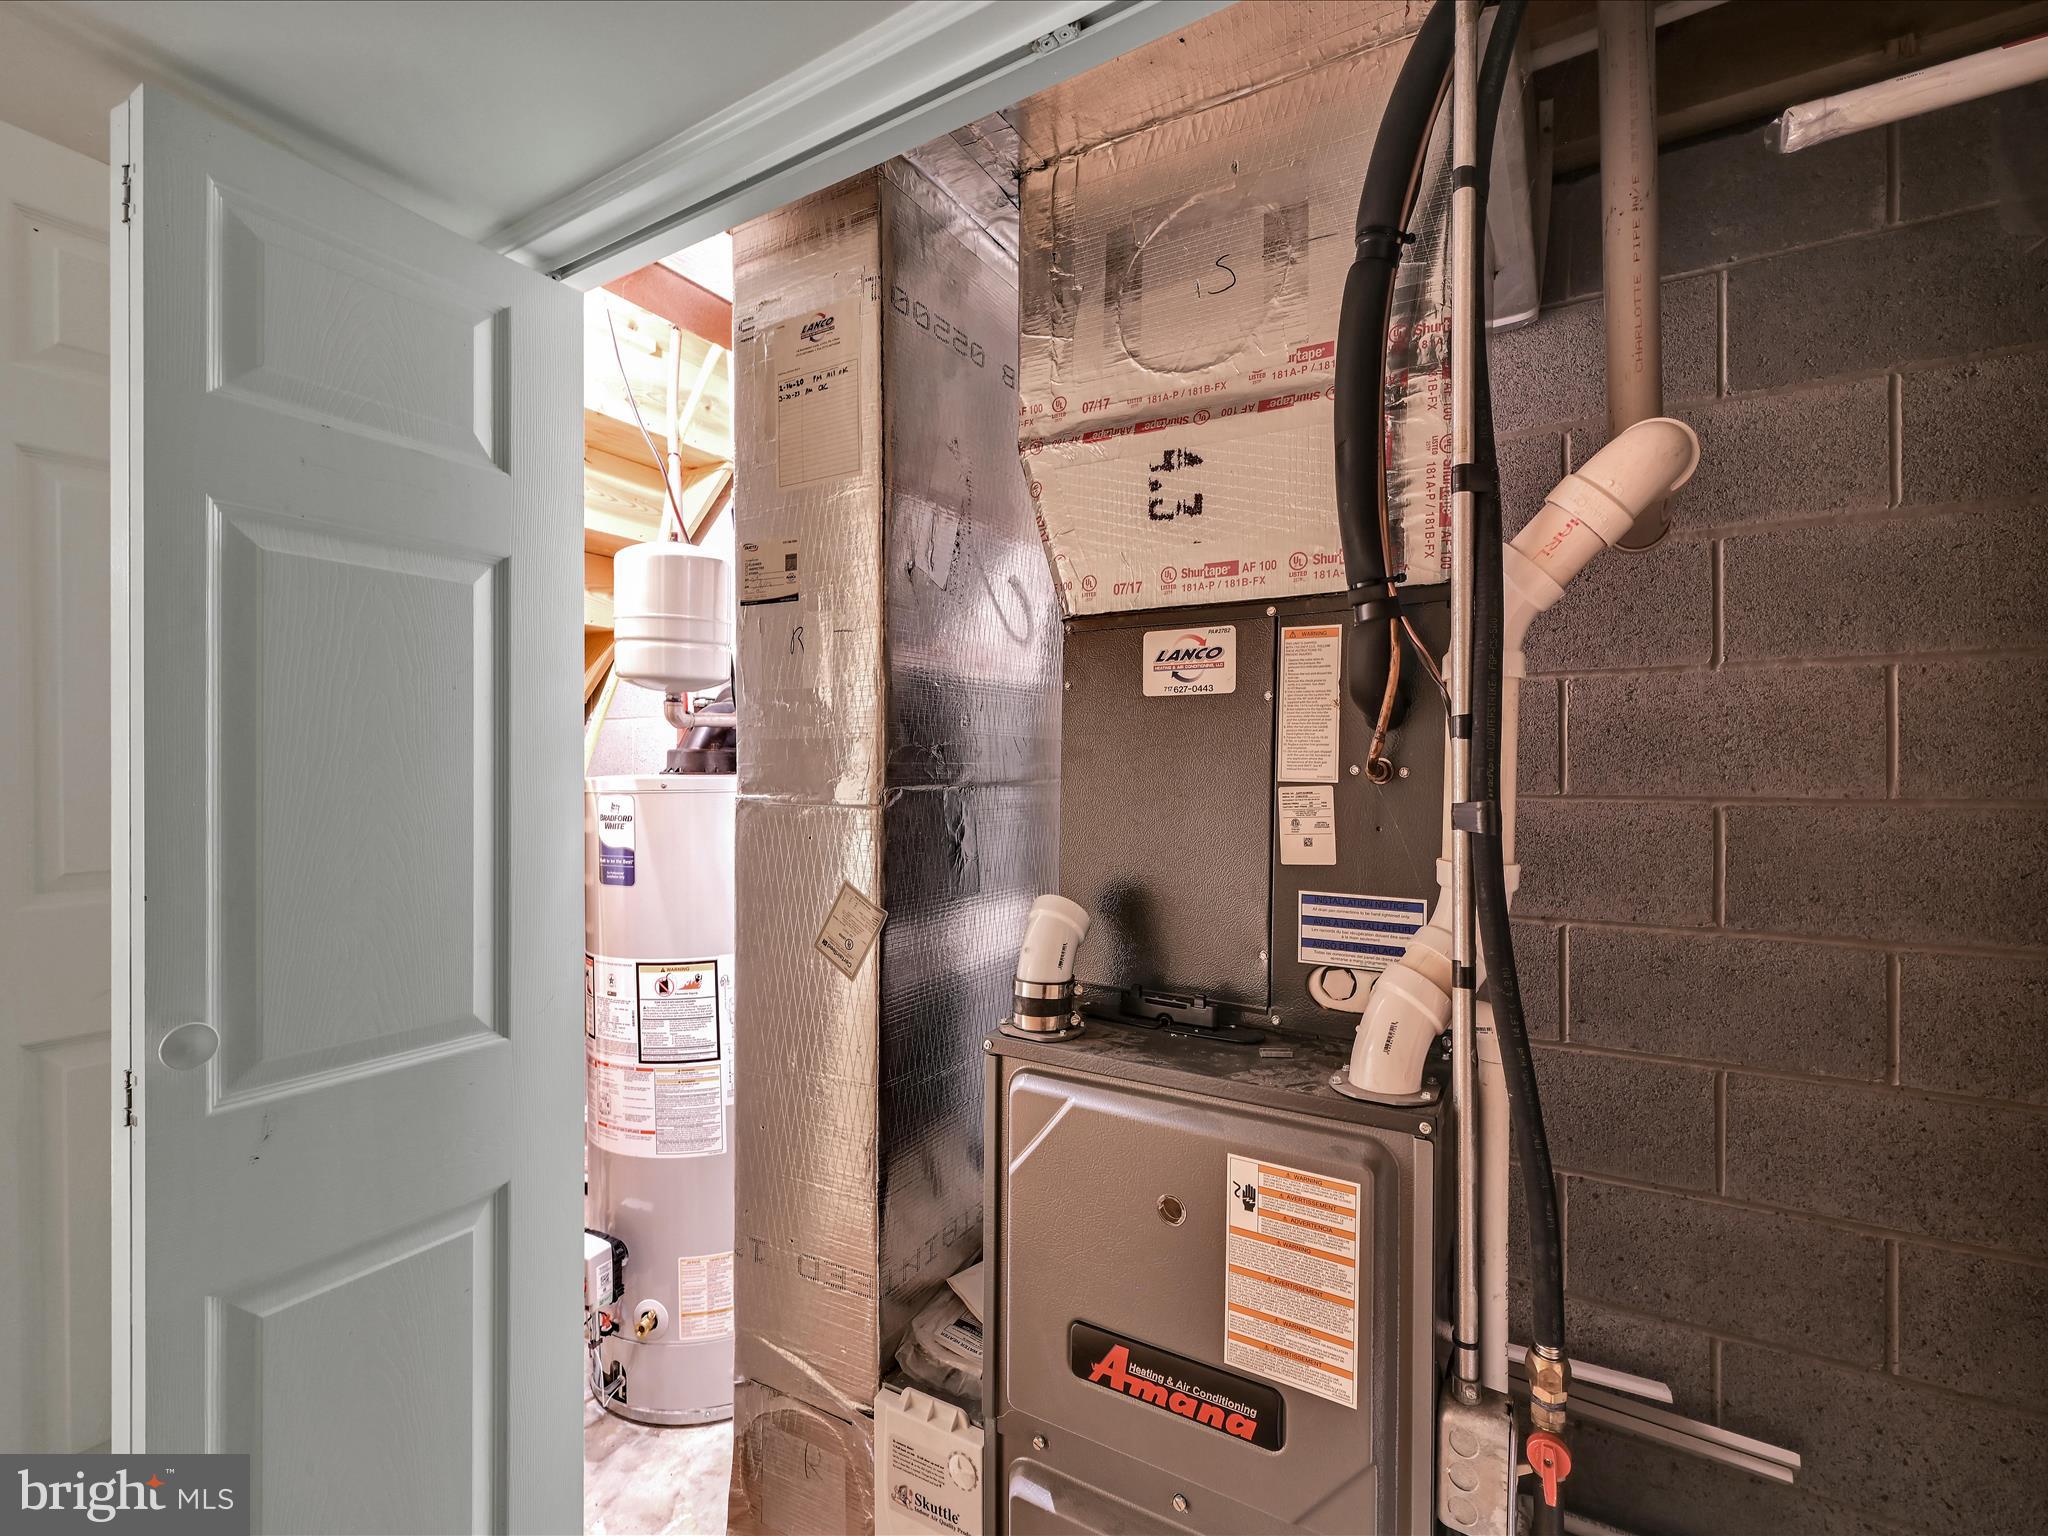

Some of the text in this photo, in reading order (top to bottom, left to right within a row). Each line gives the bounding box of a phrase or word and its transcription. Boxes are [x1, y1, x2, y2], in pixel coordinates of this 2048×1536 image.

[1633, 219, 1641, 262] PIPE
[801, 316, 834, 334] LANCO
[1633, 272, 1643, 373] CHARLOTTE
[1248, 372, 1266, 380] LISTED
[1272, 365, 1308, 380] 181A-P
[1147, 391, 1179, 404] 181A-P
[1188, 381, 1227, 397] 181B-FX
[1030, 403, 1043, 413] 100
[1082, 398, 1111, 414] 07/17
[1221, 407, 1237, 417] 100
[1242, 404, 1255, 413] AF
[1018, 419, 1034, 427] -FX
[1426, 462, 1436, 500] 181A-P
[1424, 511, 1435, 558] 181B-FX
[1181, 566, 1229, 579] Shurtape
[1242, 562, 1256, 573] AF
[1260, 560, 1277, 571] 100
[1289, 570, 1307, 578] LISTED
[1113, 581, 1142, 596] 07/17
[1182, 582, 1215, 592] 181A-P
[1226, 576, 1266, 588] 181B-FX
[1156, 646, 1223, 662] LANCO
[1173, 684, 1214, 694] 627-0443
[600, 814, 632, 822] BRADFORD
[604, 822, 625, 830] WHITE
[1314, 896, 1408, 910] INSTALLATION NOTICE
[1312, 940, 1336, 950] AVISO
[1338, 943, 1351, 951] DE
[1294, 1175, 1322, 1186] WARNING
[1286, 1195, 1337, 1212] AVERTISSEMENT
[1291, 1218, 1333, 1233] ADVERTENCIA
[1283, 1241, 1311, 1255] WARNING
[1273, 1279, 1322, 1298] AVERTISSEMENT
[1283, 1321, 1311, 1334] WARNING
[941, 1332, 960, 1345] HEATER
[1272, 1347, 1322, 1367] AVERTISSEMENT
[1088, 1344, 1257, 1440] Amana
[1129, 1362, 1257, 1418] Heating & Air Conditioning
[914, 1493, 958, 1524] Skuttle
[914, 1507, 930, 1517] Indoor
[939, 1519, 956, 1532] Quality
